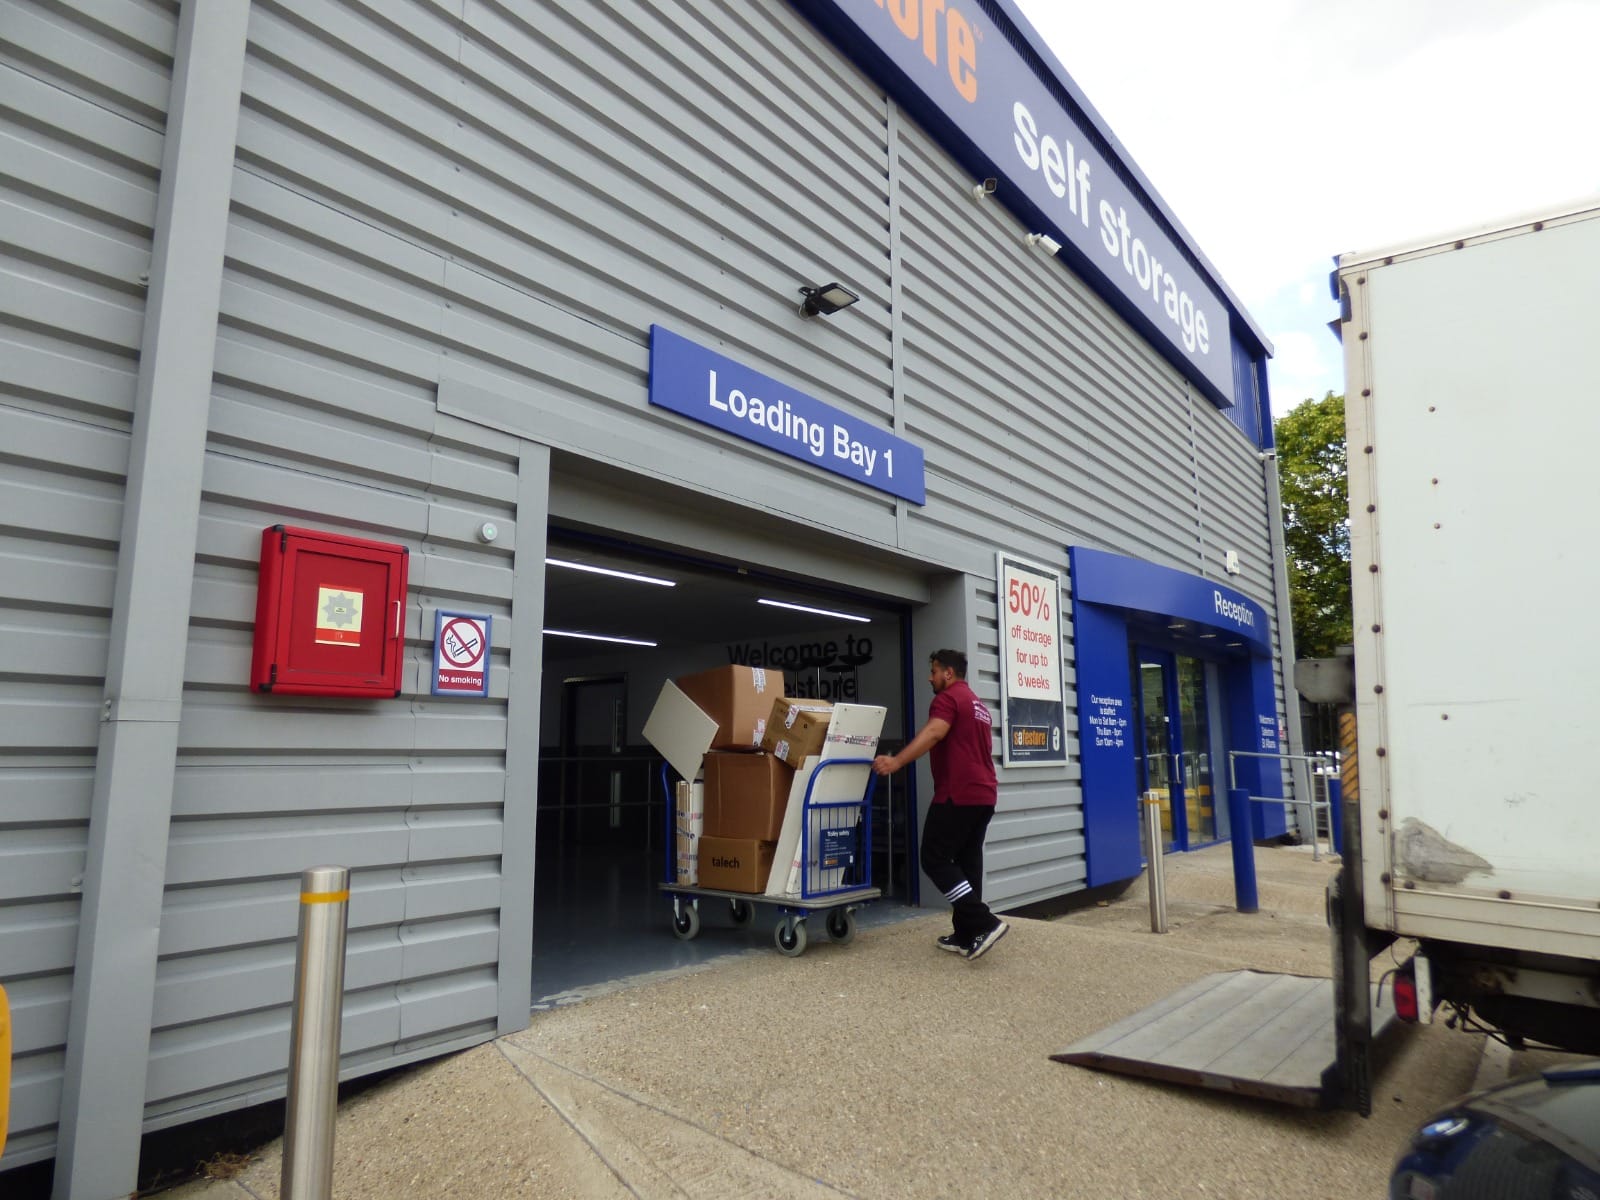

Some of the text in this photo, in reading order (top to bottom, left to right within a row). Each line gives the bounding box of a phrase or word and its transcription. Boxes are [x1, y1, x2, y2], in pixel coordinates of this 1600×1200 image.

[1013, 101, 1209, 354] Self storage
[709, 369, 893, 479] Loading Bay 1
[1009, 578, 1050, 621] 50%
[1214, 590, 1255, 627] Reception
[1011, 625, 1052, 646] off storage
[727, 633, 873, 667] Welcome to
[1016, 648, 1048, 668] for up to
[438, 674, 482, 687] No smoking
[1017, 672, 1050, 690] 8 weeks
[1013, 729, 1046, 746] safestore
[712, 856, 739, 870] talech
